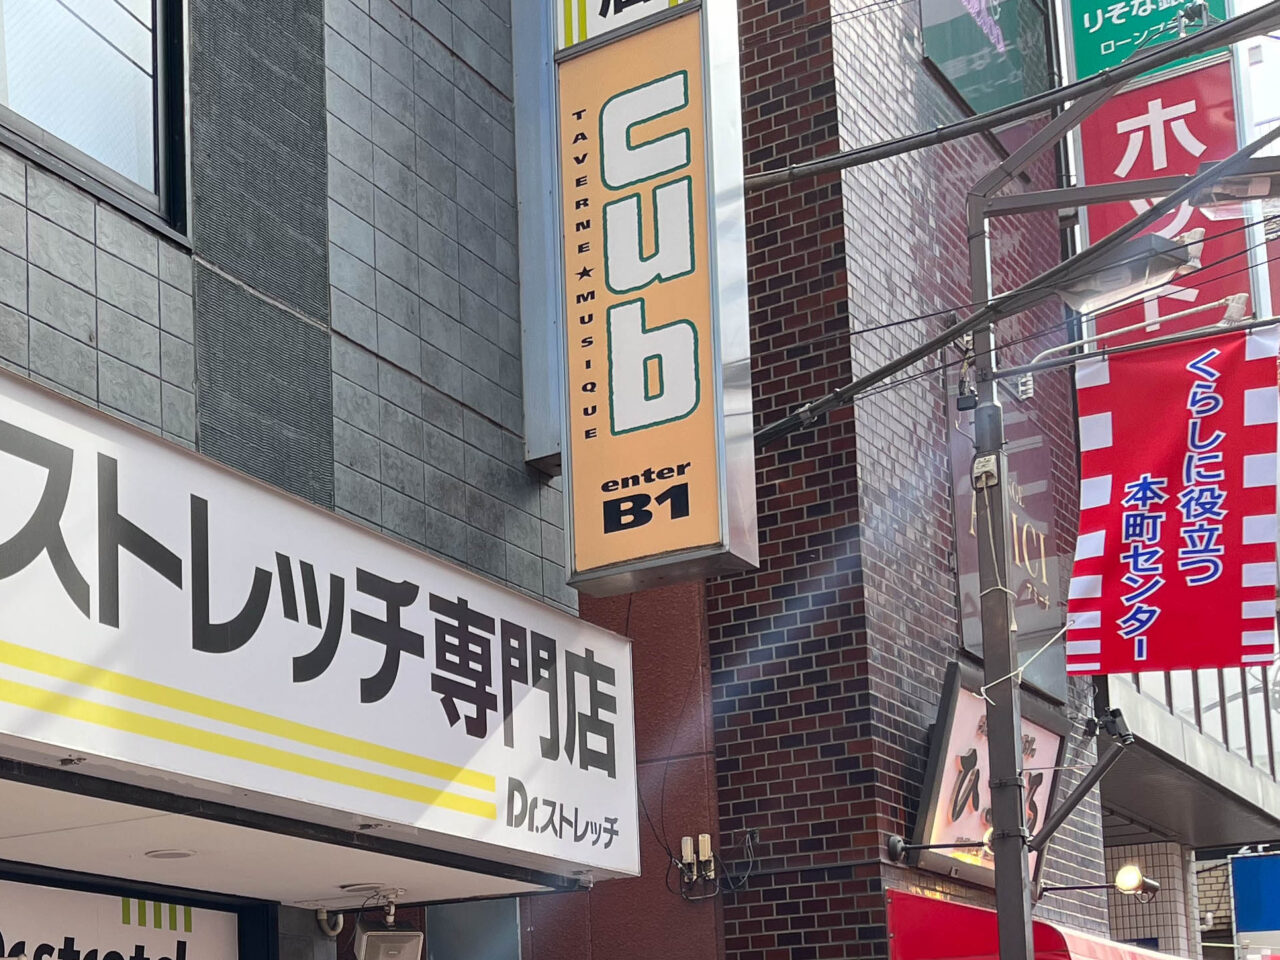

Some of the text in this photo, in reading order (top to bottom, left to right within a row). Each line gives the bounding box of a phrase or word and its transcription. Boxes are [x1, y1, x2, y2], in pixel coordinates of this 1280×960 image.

[601, 462, 691, 493] enter
[1178, 348, 1228, 587] くらしに役立つ
[603, 482, 690, 535] B1
[1117, 473, 1169, 661] 本町センター
[506, 776, 619, 850] Dr.ストレッチ
